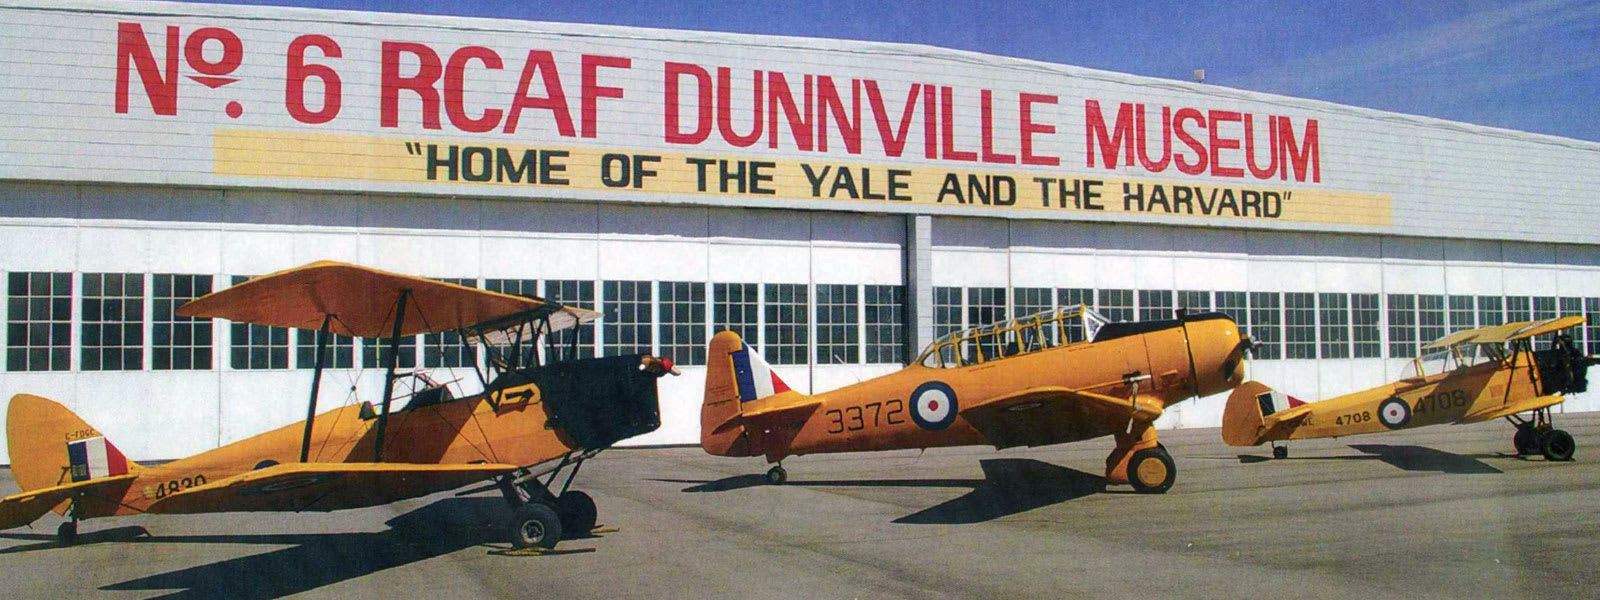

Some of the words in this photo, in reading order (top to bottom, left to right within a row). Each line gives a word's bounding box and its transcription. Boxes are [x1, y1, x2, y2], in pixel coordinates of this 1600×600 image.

[286, 35, 342, 124] 6
[381, 42, 631, 138] RCAF
[665, 62, 1059, 166] DUNNVILLE
[1085, 100, 1319, 182] MUSEUM
[406, 143, 569, 185] "HOME
[602, 154, 661, 188] OF
[687, 158, 775, 194] THE
[802, 164, 912, 201] YALE
[937, 173, 1016, 205] AND
[1034, 178, 1104, 210] THE
[1124, 183, 1291, 217] HARVARD"
[825, 399, 905, 434] 3372
[1335, 411, 1371, 426] 4708
[1413, 389, 1465, 414] 4708
